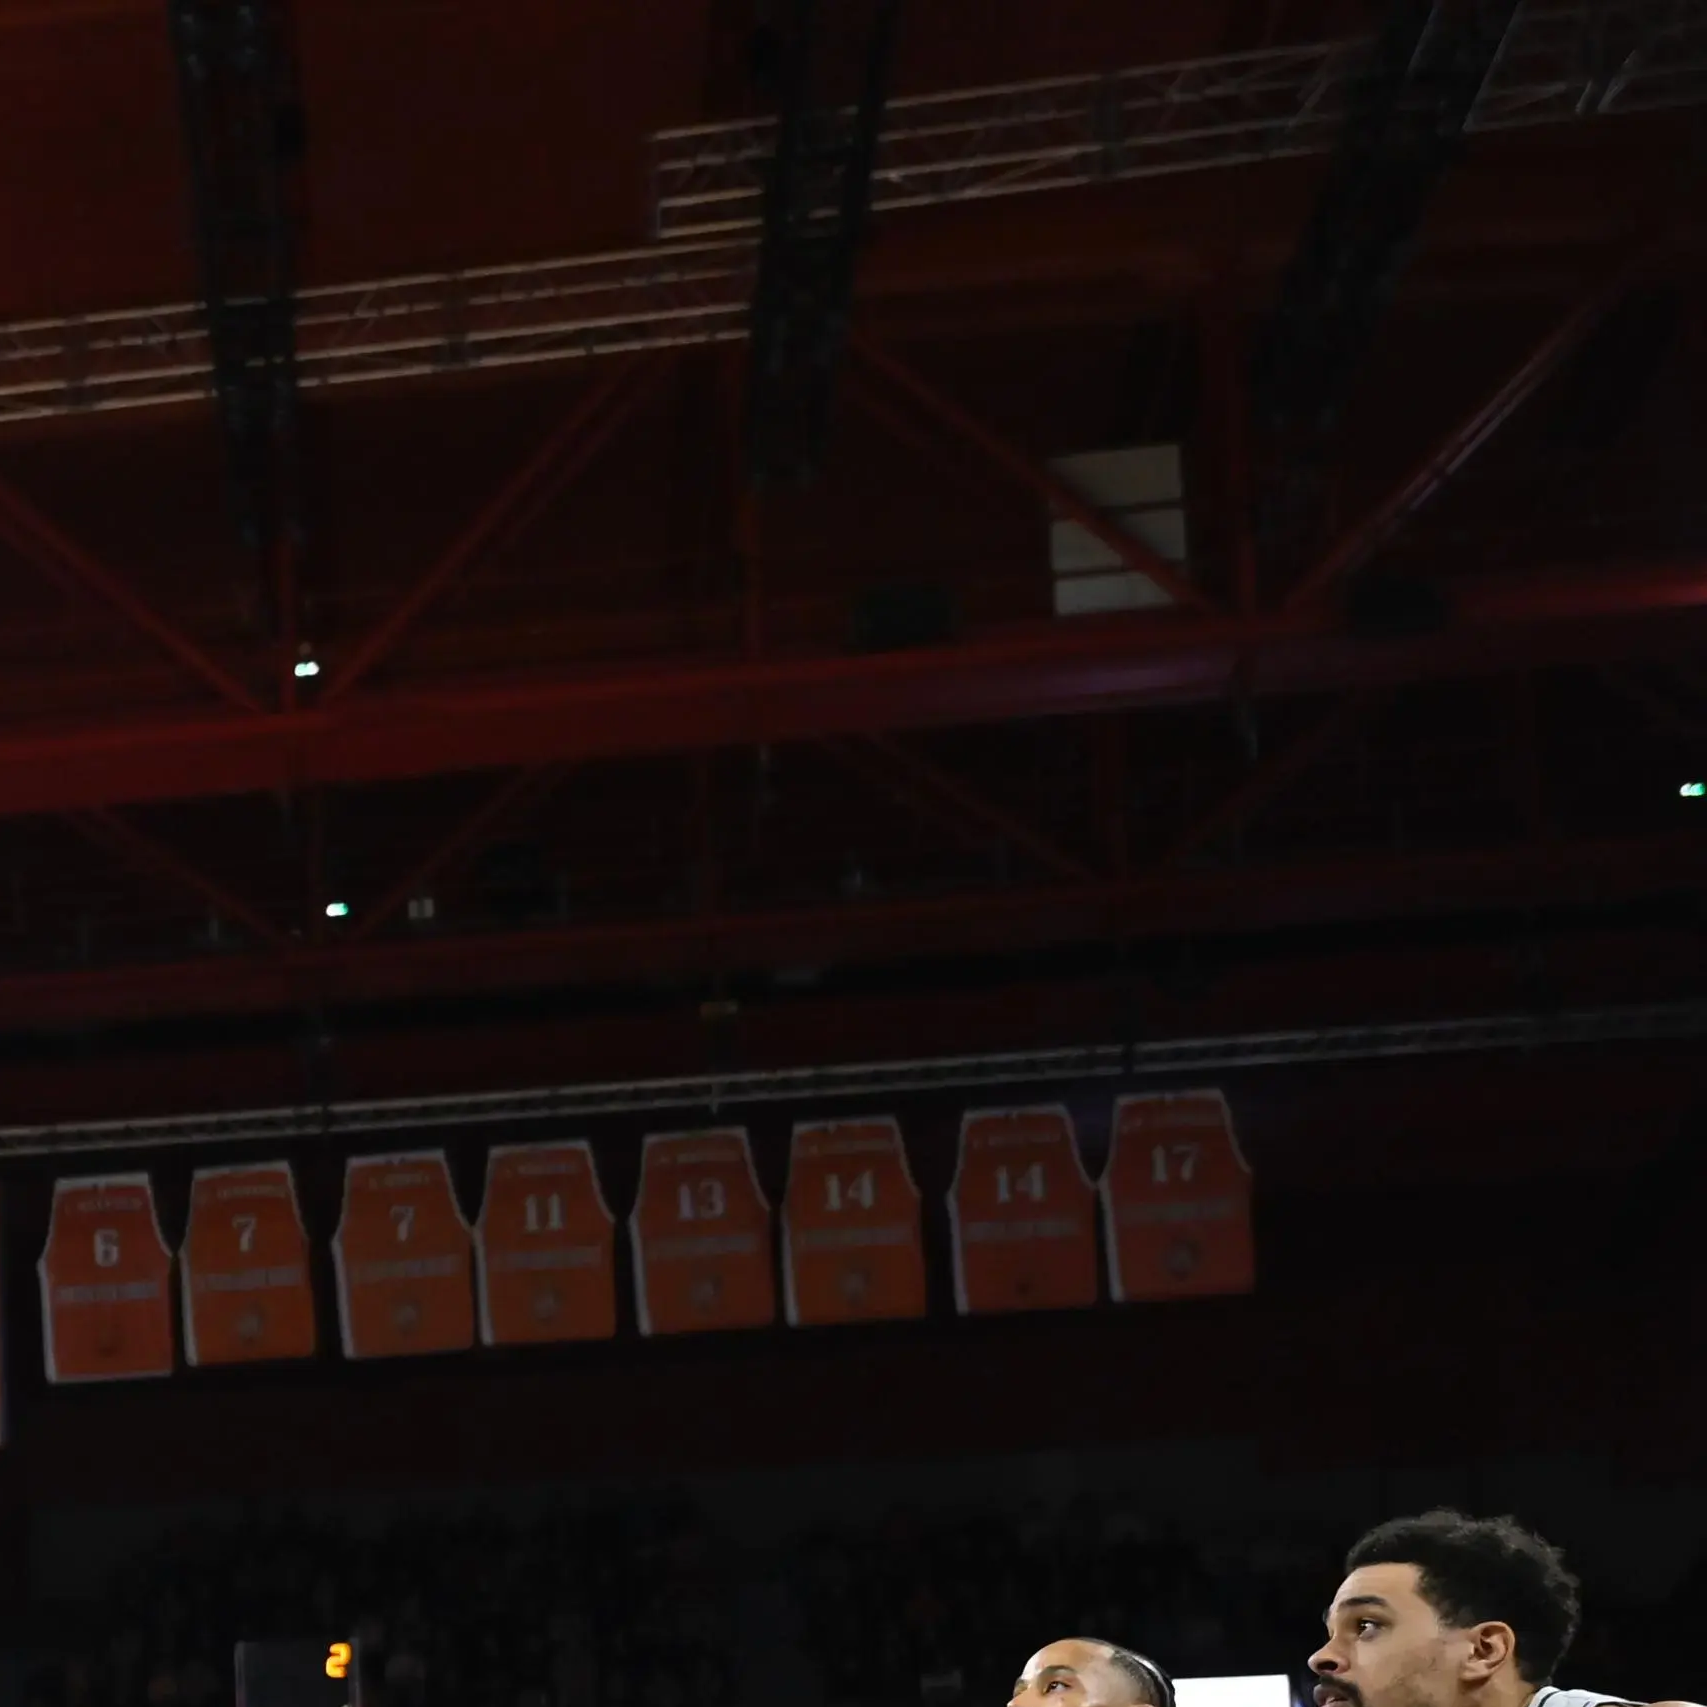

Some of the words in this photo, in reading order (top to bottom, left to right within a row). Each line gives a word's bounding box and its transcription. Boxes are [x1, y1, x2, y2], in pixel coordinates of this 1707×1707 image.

[824, 1170, 876, 1210] 14
[994, 1162, 1048, 1204] 14
[231, 1215, 257, 1253] 7
[390, 1205, 417, 1242] 7
[326, 1643, 351, 1678] 2
